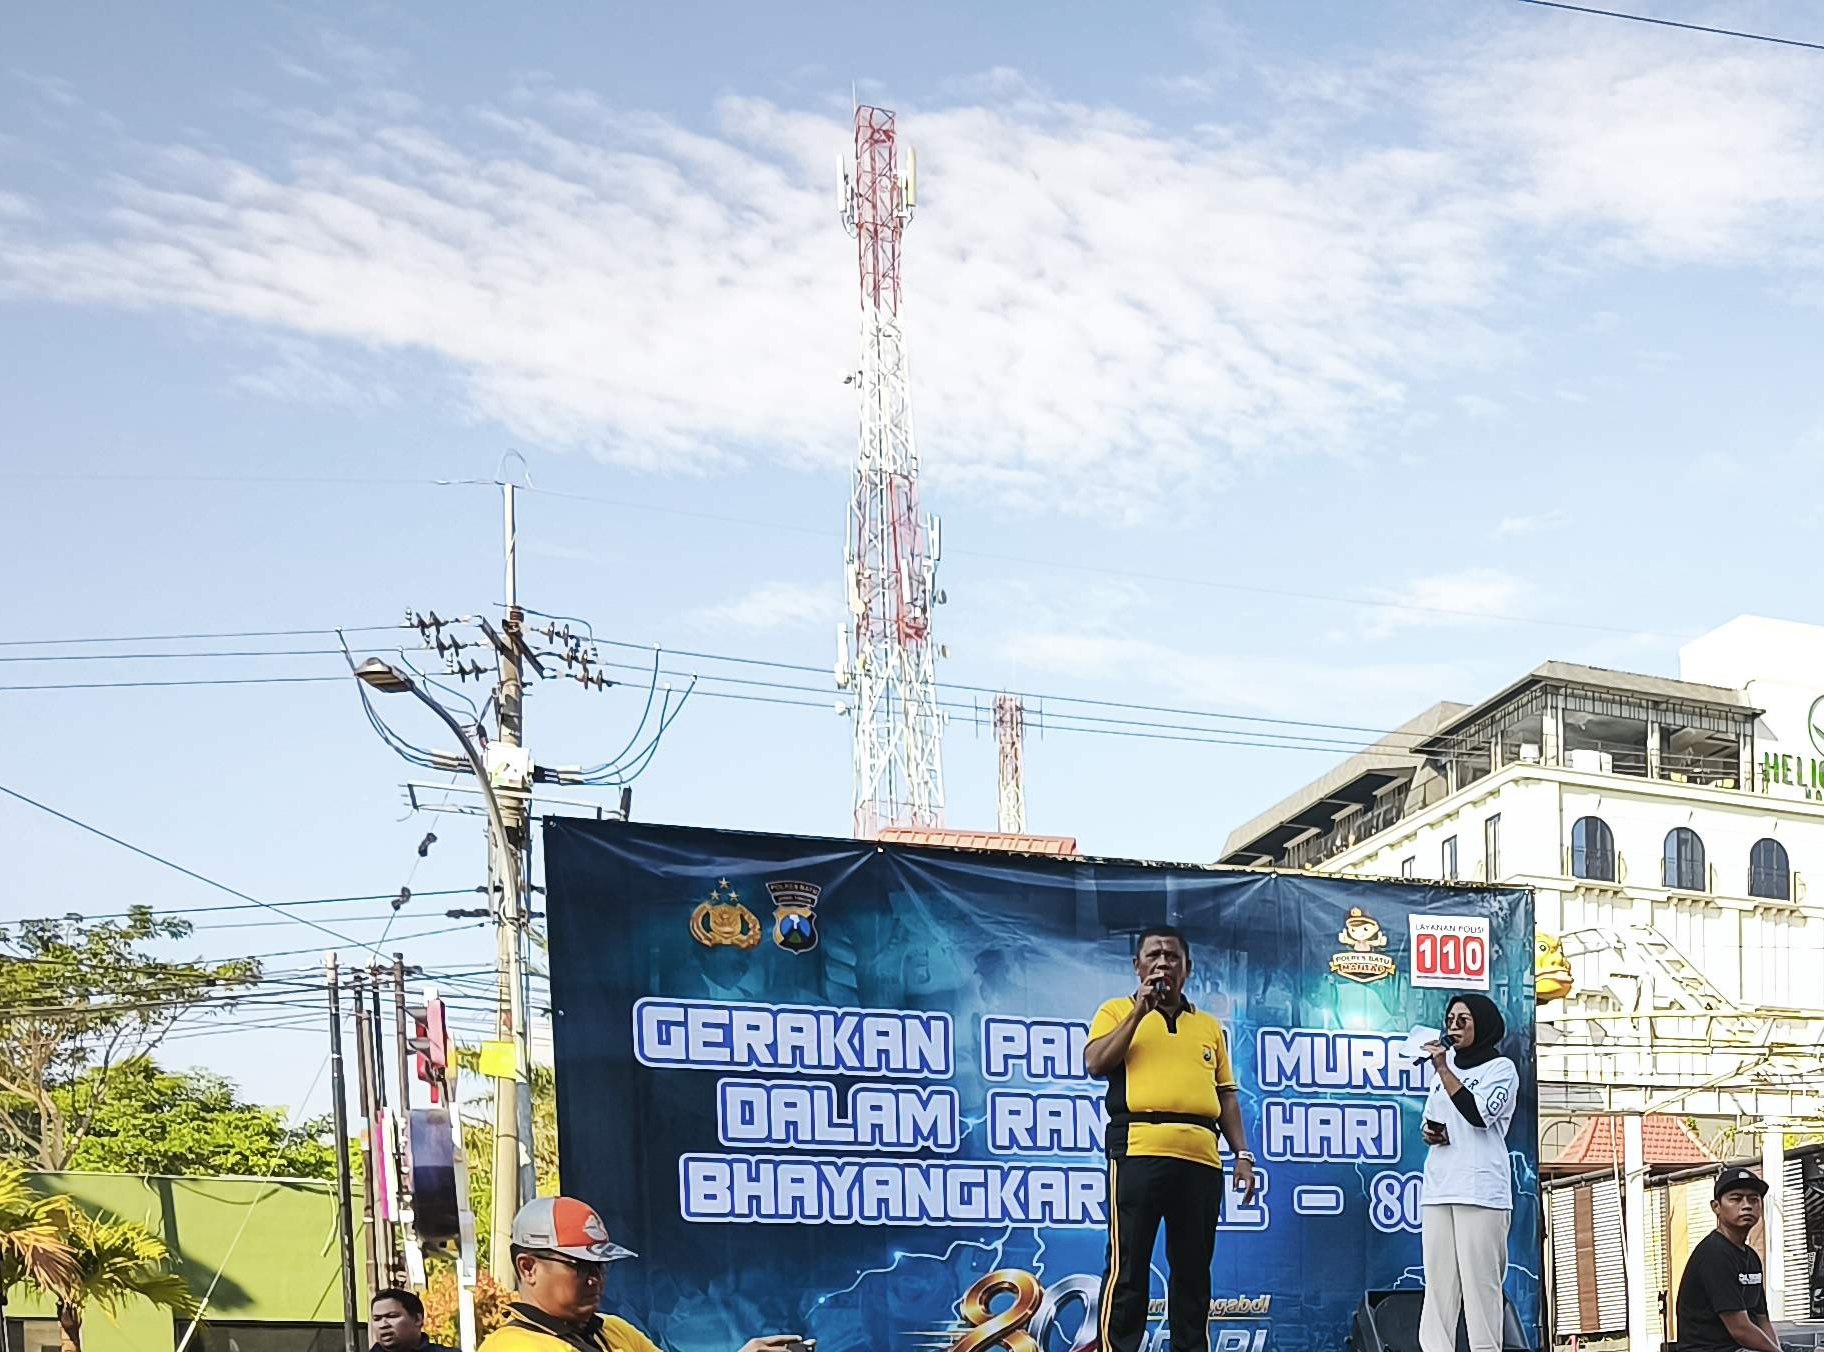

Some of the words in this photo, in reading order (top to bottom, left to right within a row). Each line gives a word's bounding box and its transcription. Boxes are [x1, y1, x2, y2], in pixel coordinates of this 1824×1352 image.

[1415, 924, 1456, 932] LAYANAN
[1418, 936, 1484, 974] 110
[637, 1001, 951, 1077] GERAKAN
[1260, 1032, 1432, 1092] MURA
[720, 1081, 957, 1150] DALAM
[1266, 1102, 1398, 1159] HARI
[1486, 1086, 1509, 1117] 6
[684, 1158, 1109, 1224] BHAYANGKAR
[1374, 1175, 1423, 1231] 80
